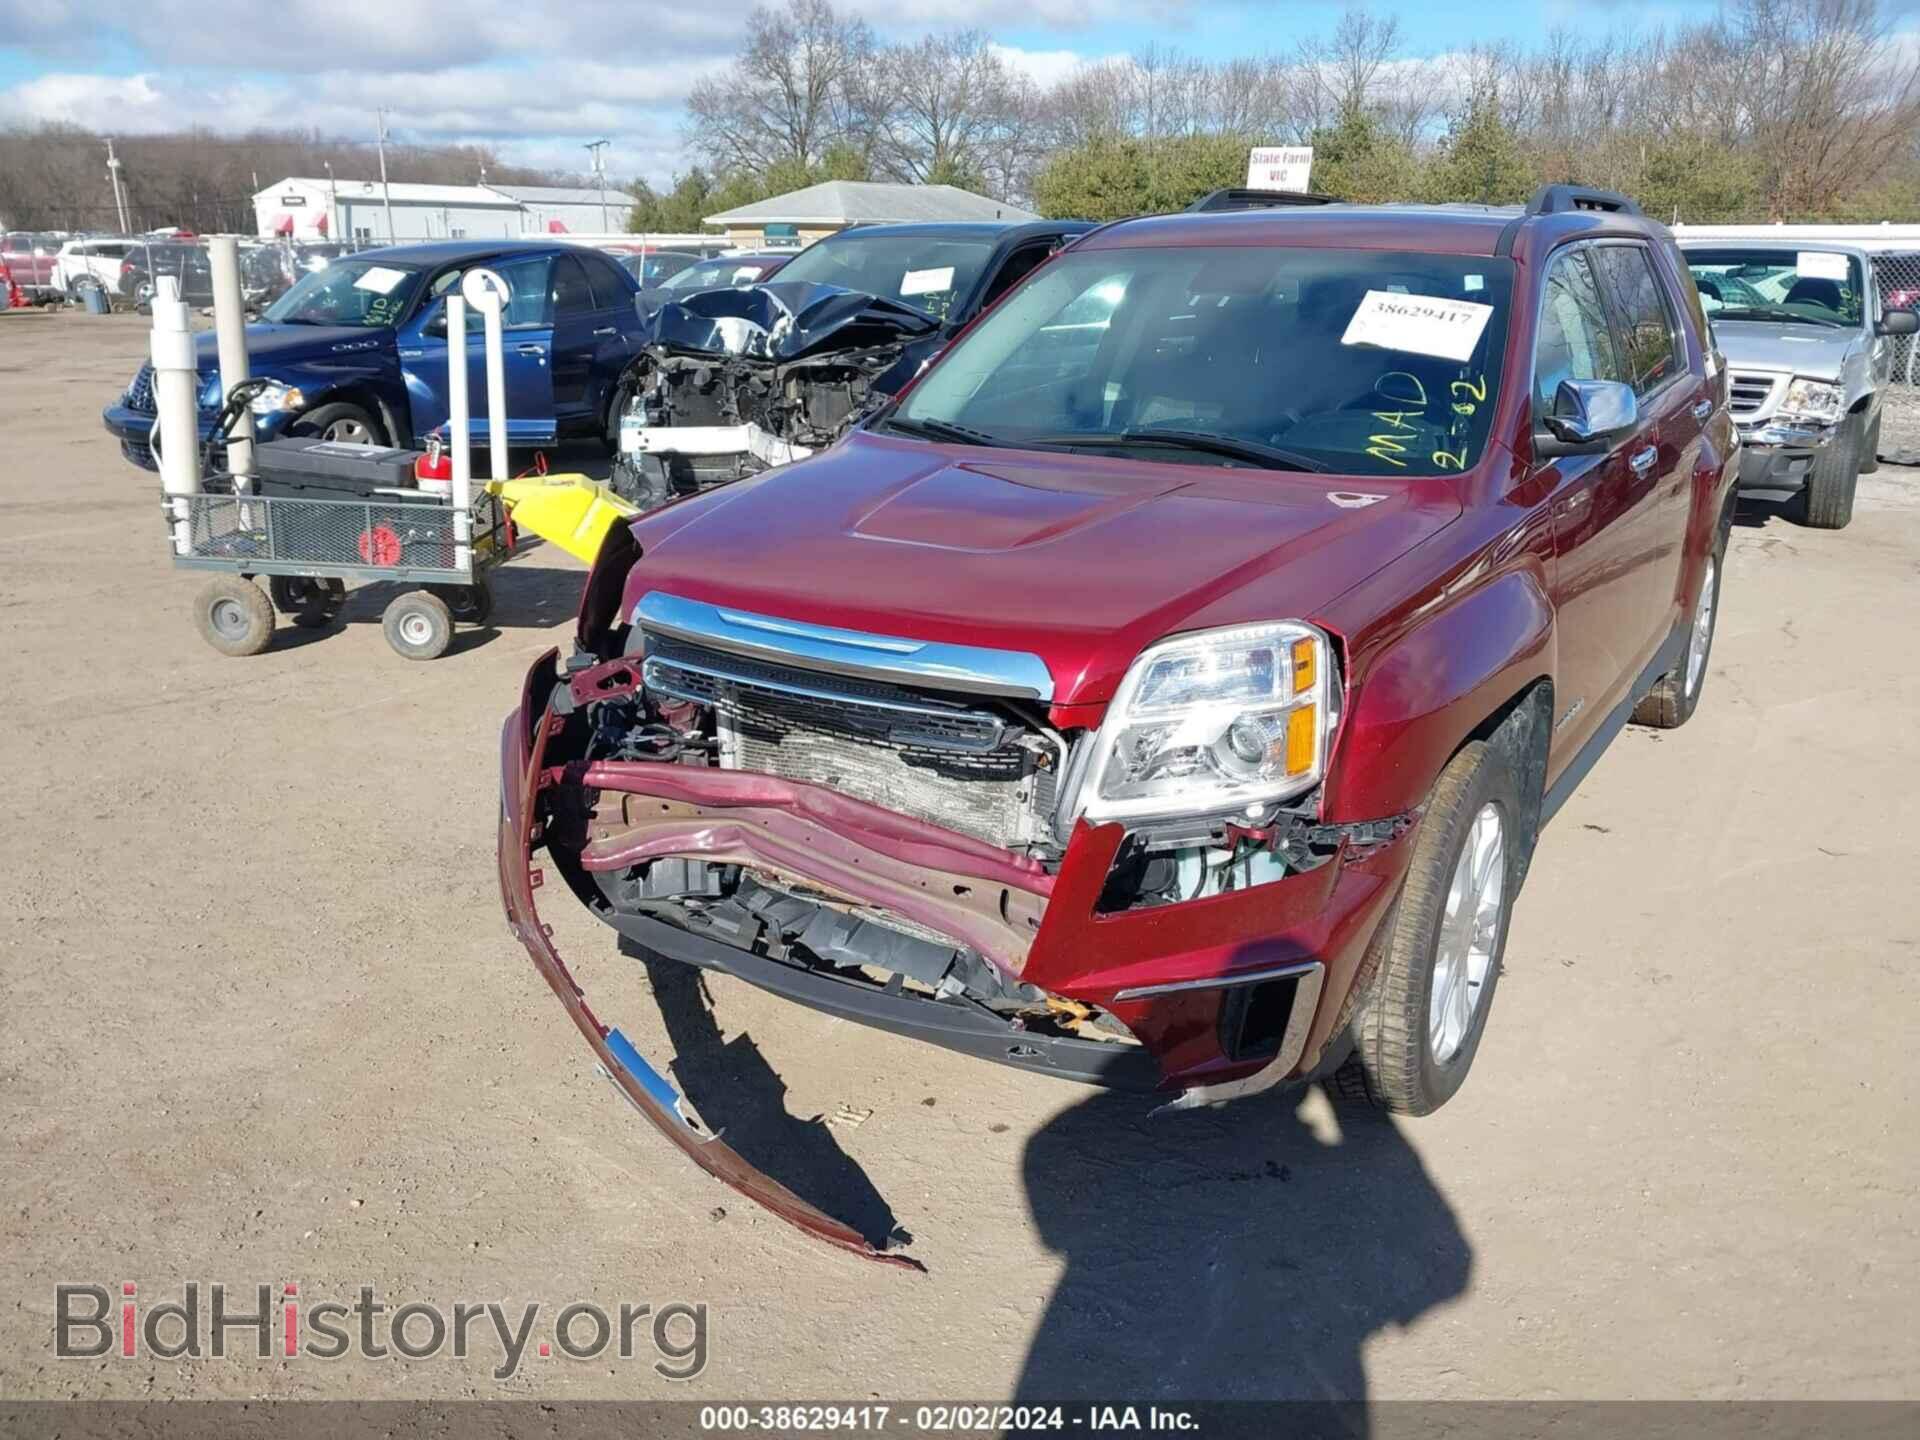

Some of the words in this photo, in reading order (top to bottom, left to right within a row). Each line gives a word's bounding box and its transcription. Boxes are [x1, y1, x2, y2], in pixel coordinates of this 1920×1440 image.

[1252, 152, 1280, 164] State
[1372, 301, 1473, 325] 38629417
[1364, 371, 1428, 467] MAD
